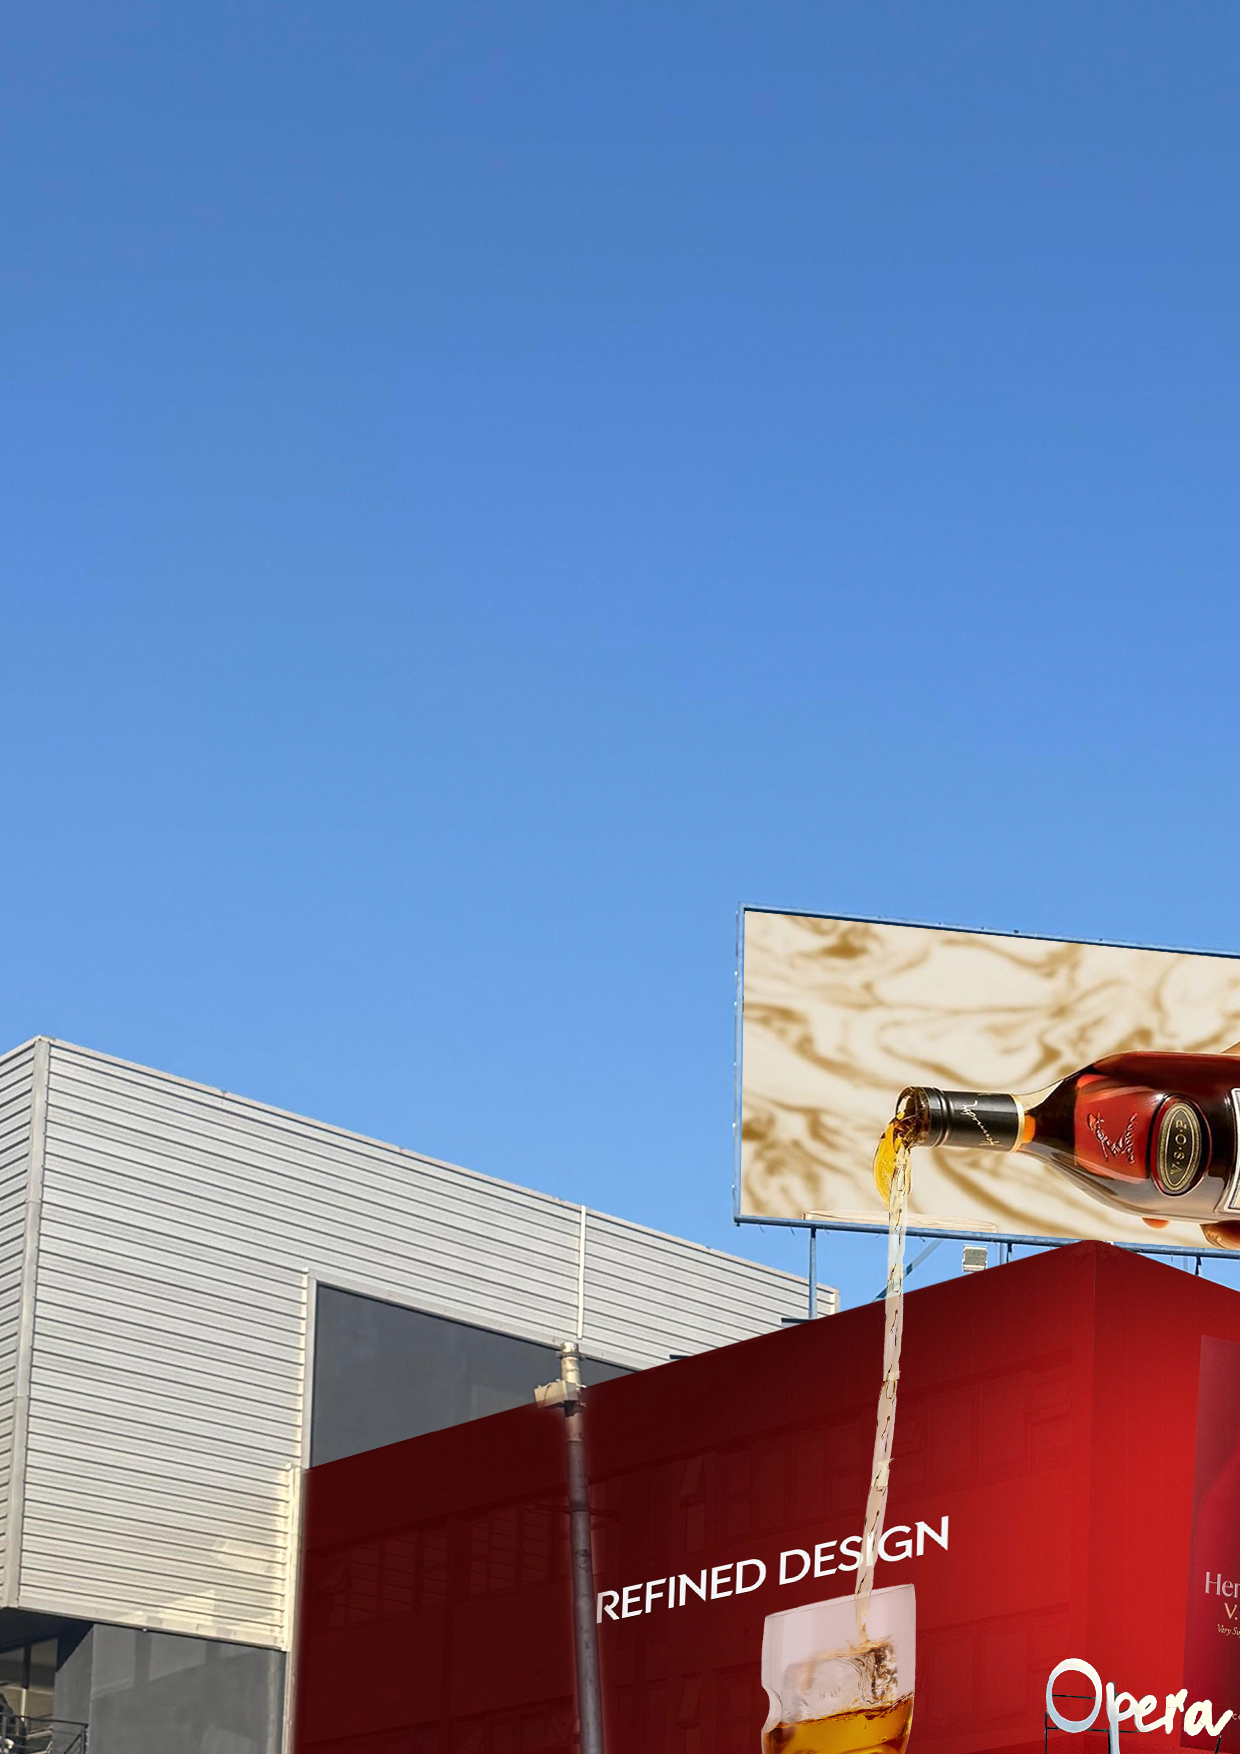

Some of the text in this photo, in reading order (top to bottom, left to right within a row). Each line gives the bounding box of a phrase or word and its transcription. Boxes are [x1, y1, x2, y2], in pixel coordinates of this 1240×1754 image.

[596, 1515, 949, 1624] REFINED DESIGN
[1217, 1624, 1232, 1636] Very
